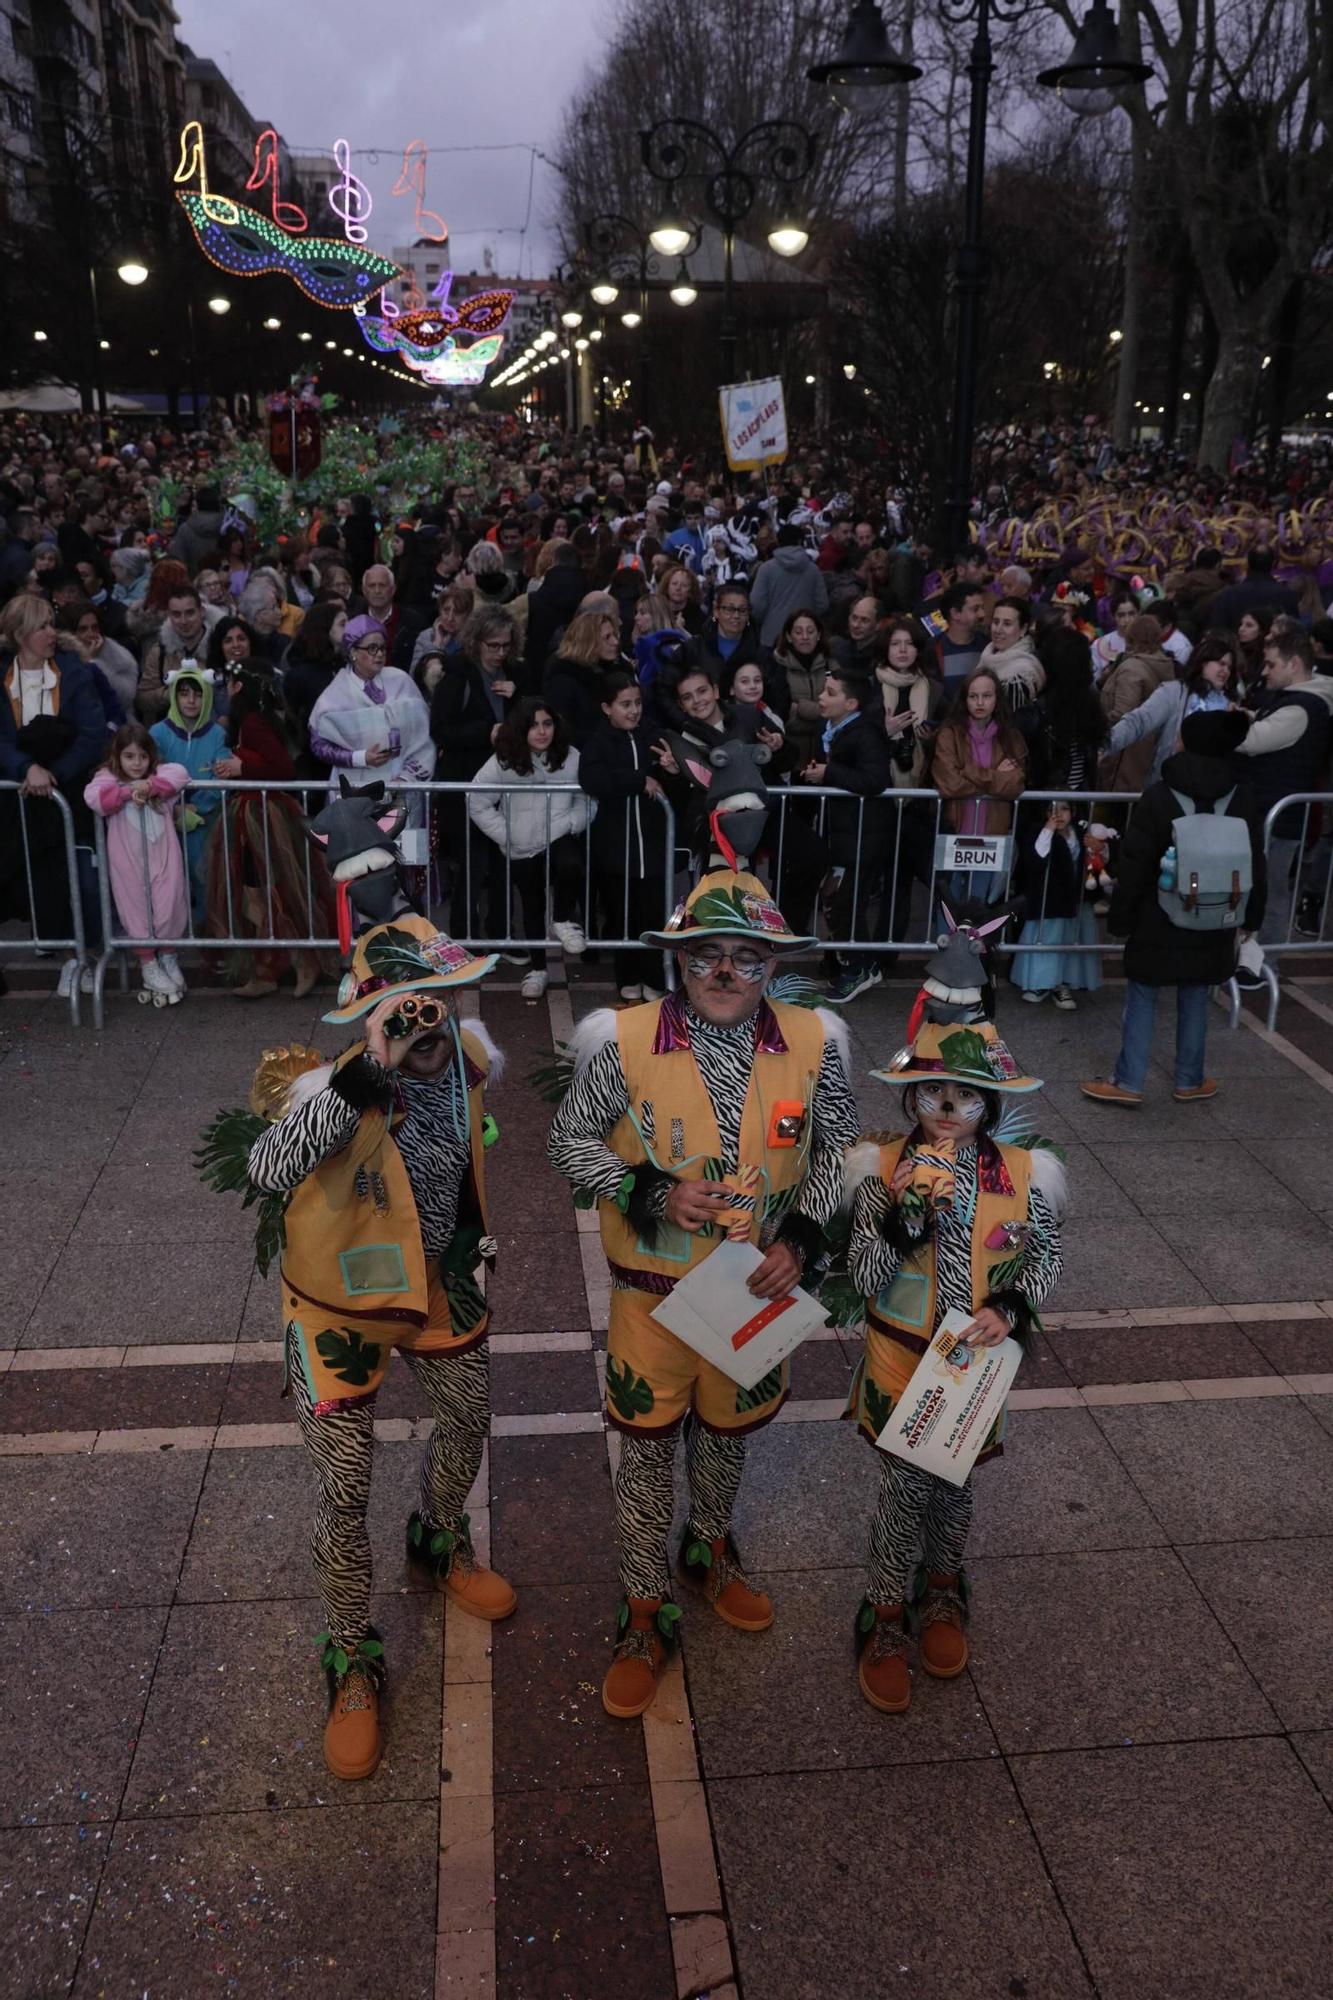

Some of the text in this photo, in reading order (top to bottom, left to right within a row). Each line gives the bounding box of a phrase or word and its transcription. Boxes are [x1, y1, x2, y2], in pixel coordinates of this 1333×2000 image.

[732, 430, 749, 450] LOS
[954, 851, 996, 864] BRUN
[900, 1389, 933, 1437] Xixón
[907, 1385, 944, 1448] ANTROXU
[932, 1398, 946, 1418] 2025
[944, 1428, 960, 1449] Los
[956, 1360, 994, 1426] Mazcaraos
